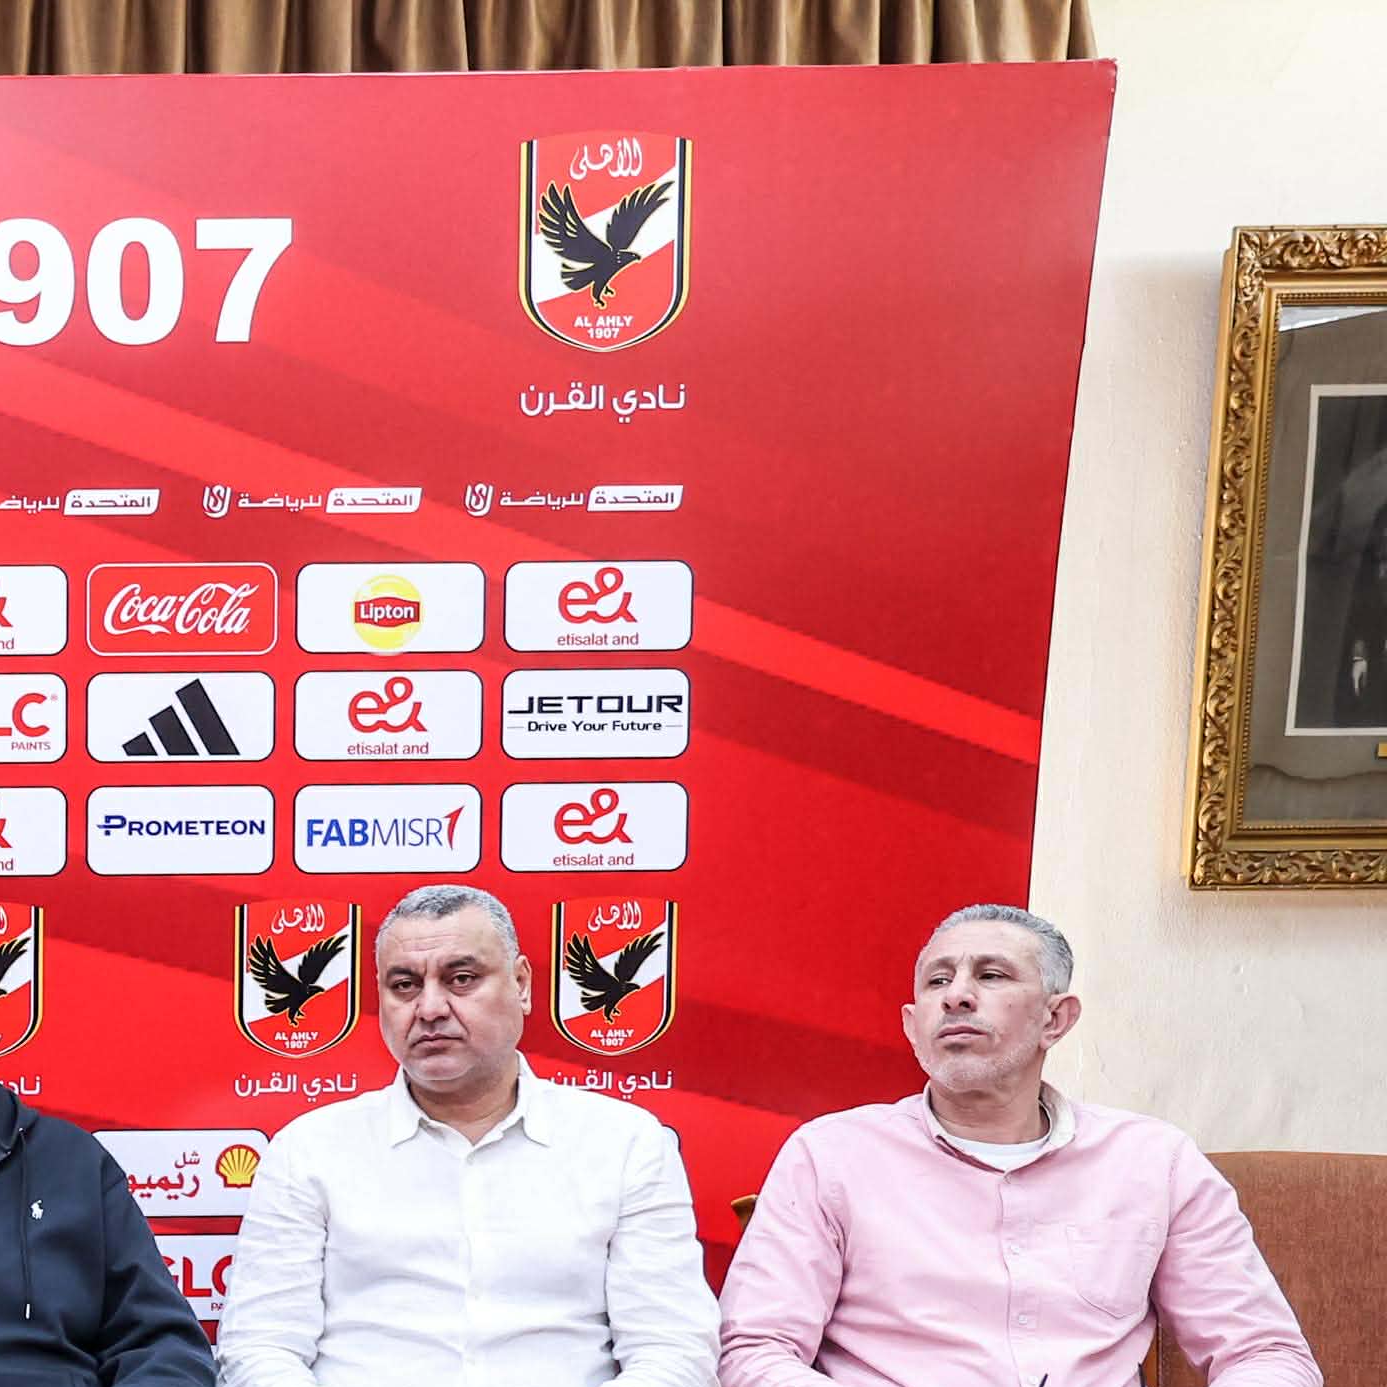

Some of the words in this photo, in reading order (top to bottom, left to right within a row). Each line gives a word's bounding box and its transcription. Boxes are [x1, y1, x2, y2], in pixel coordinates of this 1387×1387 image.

[575, 317, 592, 326] AL
[597, 316, 632, 326] AHLY
[588, 328, 619, 338] 1907
[521, 382, 603, 416] القرن
[613, 384, 684, 422] نادي
[71, 495, 150, 508] المتحدة
[239, 494, 321, 511] للرياضة
[334, 493, 412, 506] المتحدة
[500, 492, 583, 509] للرياضة
[595, 491, 674, 504] المتحدة
[104, 583, 259, 634] Coca-Cola
[361, 603, 414, 622] Lipton
[557, 633, 608, 646] etisalat
[612, 632, 639, 645] and
[508, 695, 682, 714] JETOUR
[528, 721, 567, 731] Drive
[572, 721, 605, 731] Your
[613, 720, 662, 731] Future
[11, 742, 51, 750] PAINTS
[347, 743, 398, 755] etisalat
[403, 742, 429, 754] and
[553, 854, 603, 866] etisalat
[608, 853, 634, 866] and
[275, 1032, 288, 1040] AL
[291, 1032, 318, 1041] AHLY
[601, 1038, 624, 1046] 1907
[285, 1040, 308, 1048] 1907
[235, 1072, 297, 1096] القرن
[303, 1074, 358, 1103] نادي
[618, 1071, 671, 1099] نادي
[175, 1152, 200, 1168] شل
